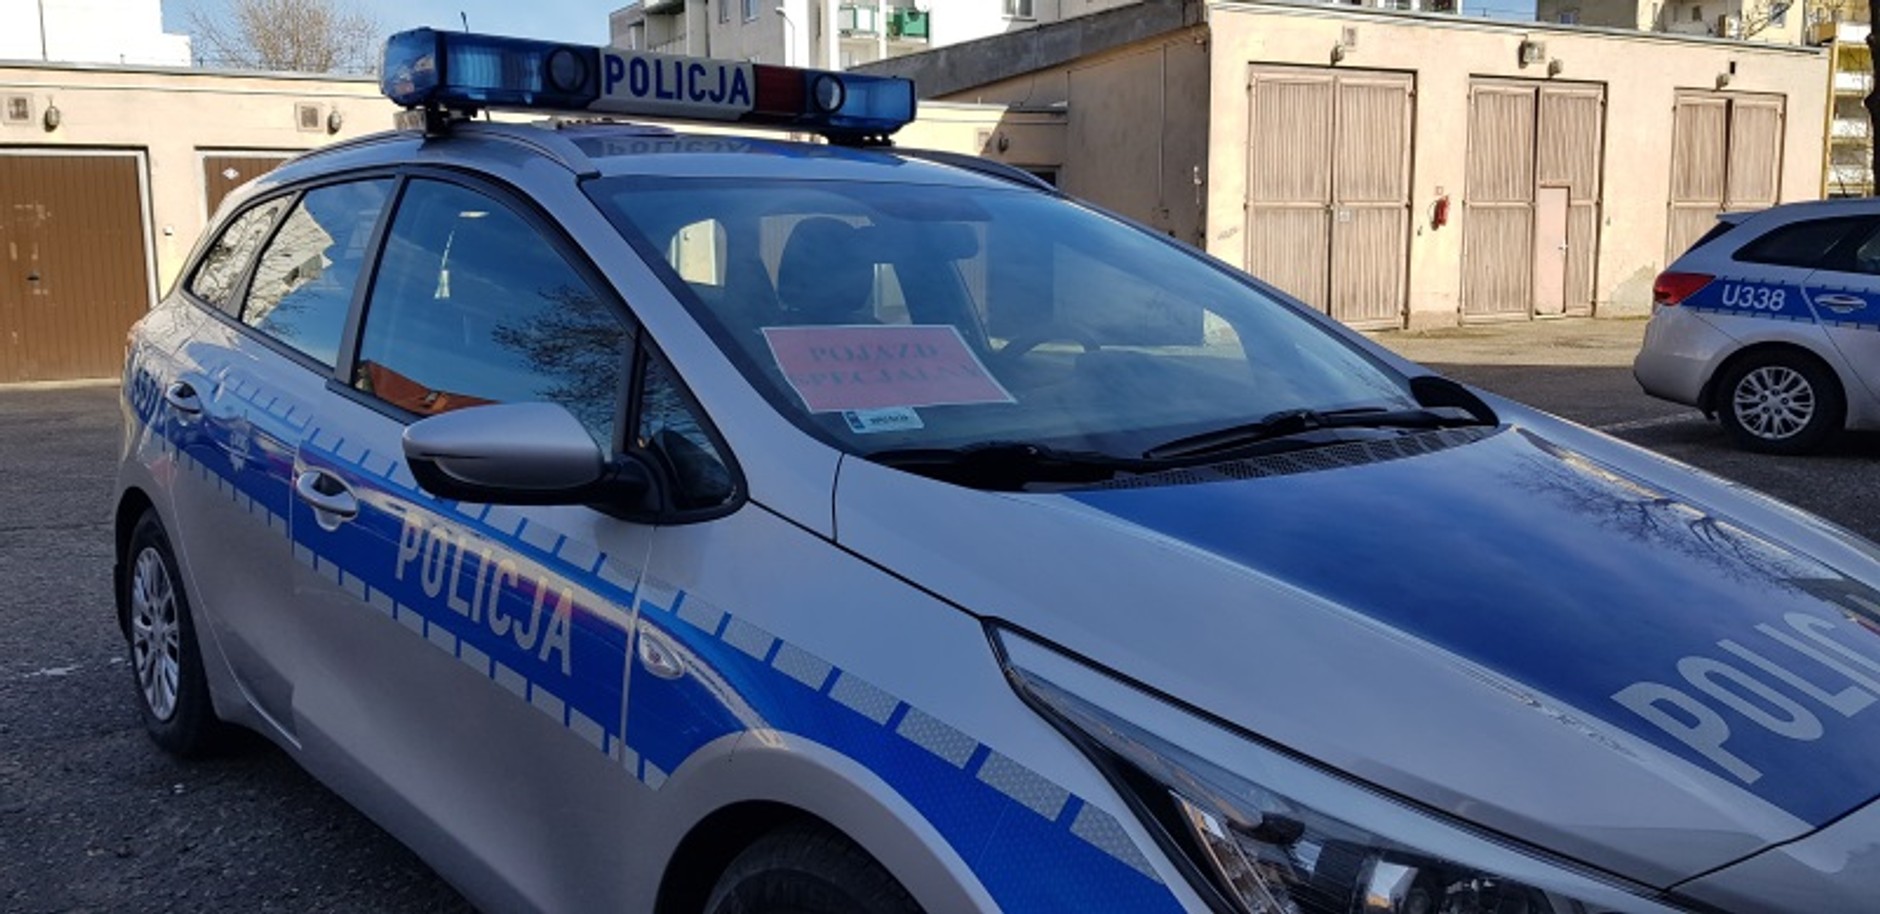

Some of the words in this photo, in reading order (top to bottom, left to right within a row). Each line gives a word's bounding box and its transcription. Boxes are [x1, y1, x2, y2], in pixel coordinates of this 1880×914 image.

[604, 54, 750, 106] POLICJA
[1722, 284, 1785, 311] U338
[808, 343, 938, 362] POJAZD
[395, 514, 572, 676] POLICJA
[1610, 594, 1880, 785] POLIC
